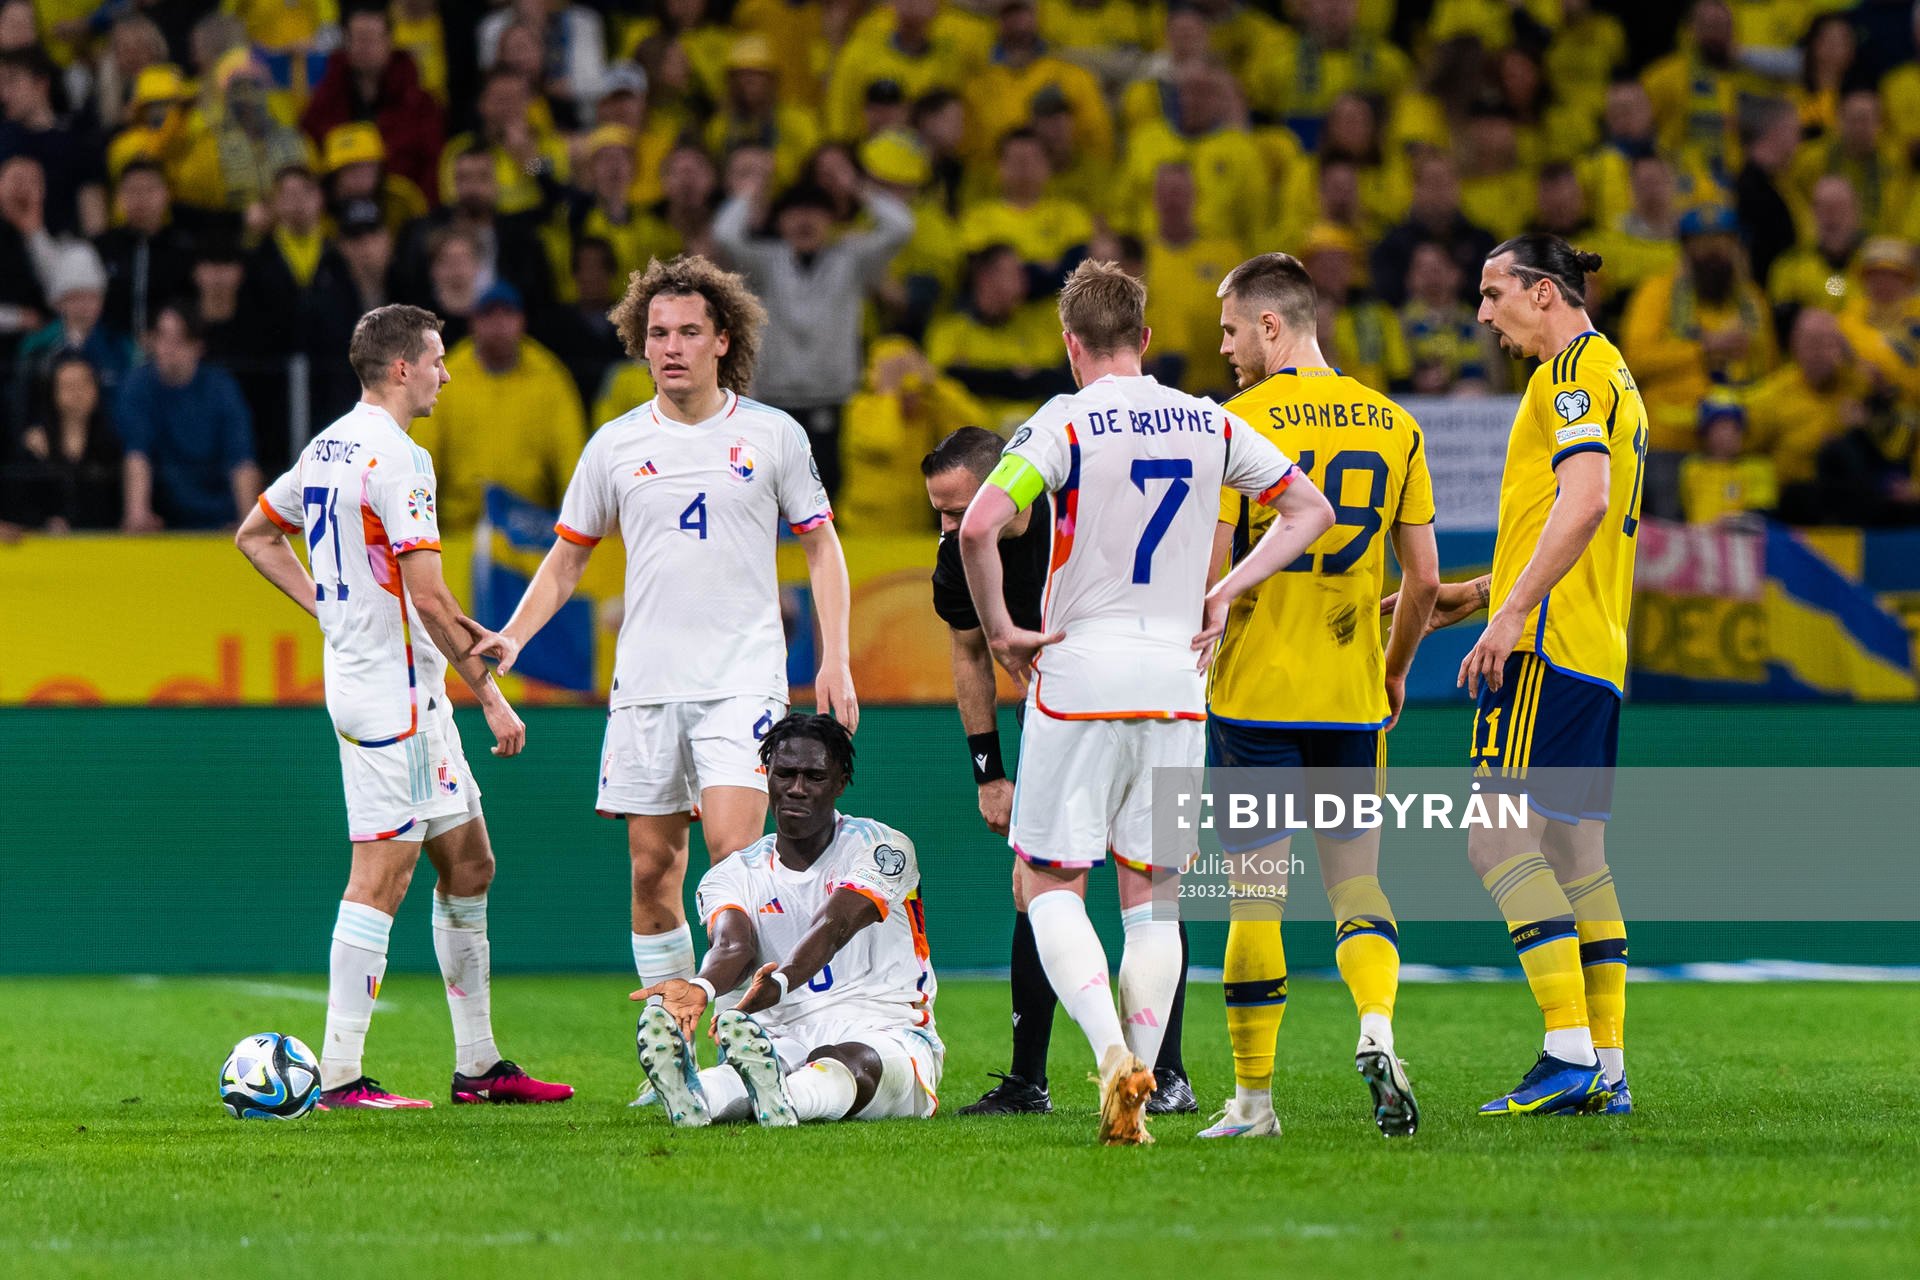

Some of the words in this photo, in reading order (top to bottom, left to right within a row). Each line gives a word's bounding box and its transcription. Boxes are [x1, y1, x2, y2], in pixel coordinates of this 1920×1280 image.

[1088, 409, 1122, 436] DE
[1128, 407, 1216, 436] BRUYNE
[1269, 403, 1394, 430] SVANBERG
[679, 492, 708, 540] 4
[1130, 458, 1193, 584] 7
